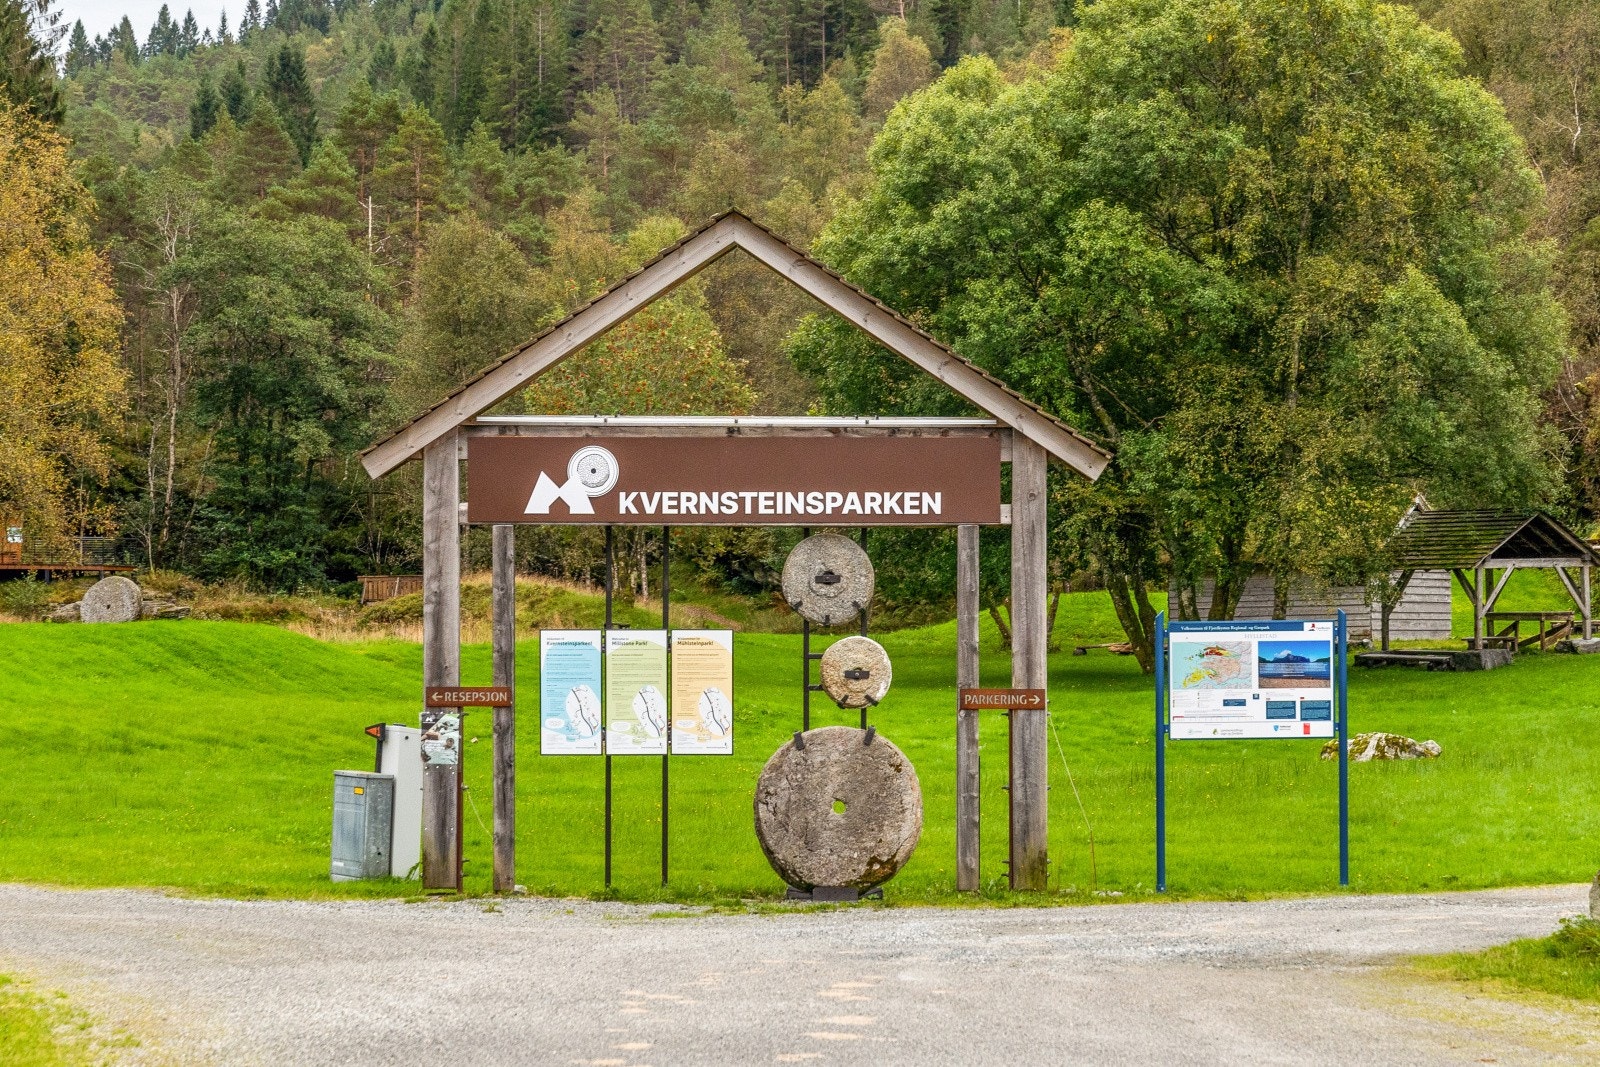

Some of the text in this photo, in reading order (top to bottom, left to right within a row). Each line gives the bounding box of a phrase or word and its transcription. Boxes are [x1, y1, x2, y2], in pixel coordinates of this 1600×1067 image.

[619, 491, 942, 515] KVERNSTEINSPARKEN
[444, 691, 507, 702] RESEPSJON
[964, 694, 1027, 705] PARKERING
